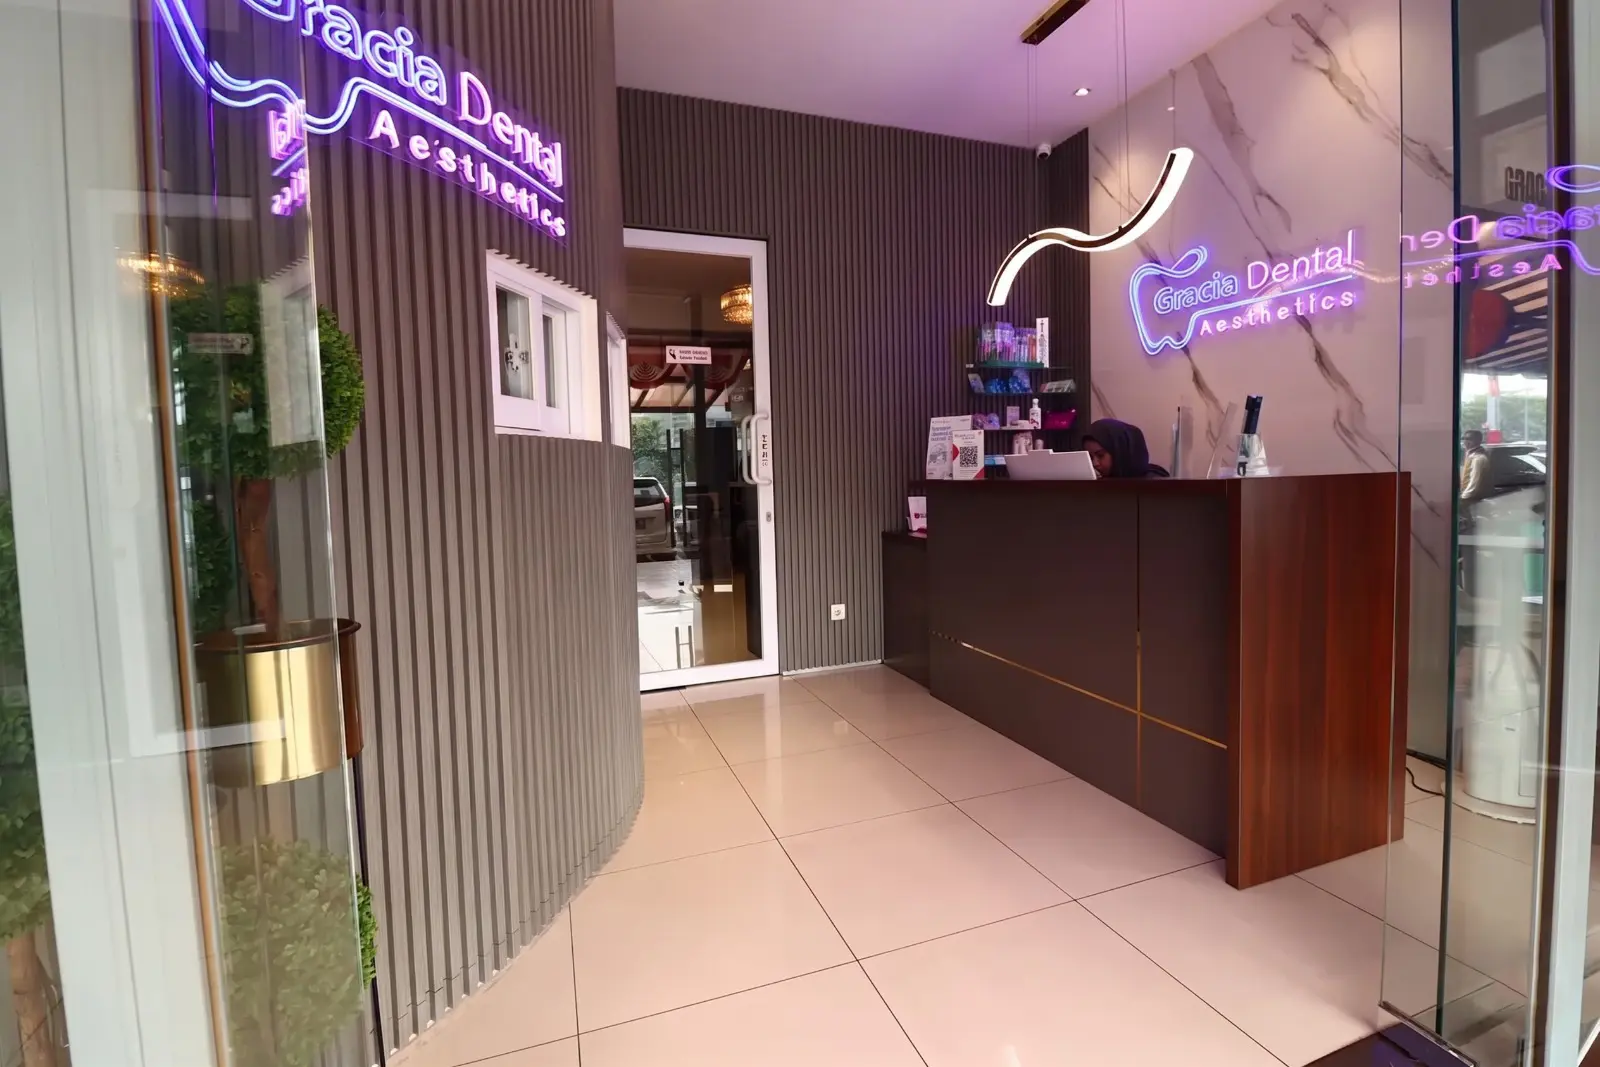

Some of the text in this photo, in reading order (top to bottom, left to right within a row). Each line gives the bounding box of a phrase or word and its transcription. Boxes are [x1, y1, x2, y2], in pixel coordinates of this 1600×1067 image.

[238, 0, 563, 188] racia Dental
[368, 110, 566, 237] Aesthetics
[1153, 229, 1356, 315] Gracia Dental
[1200, 291, 1354, 336] Aesthetics
